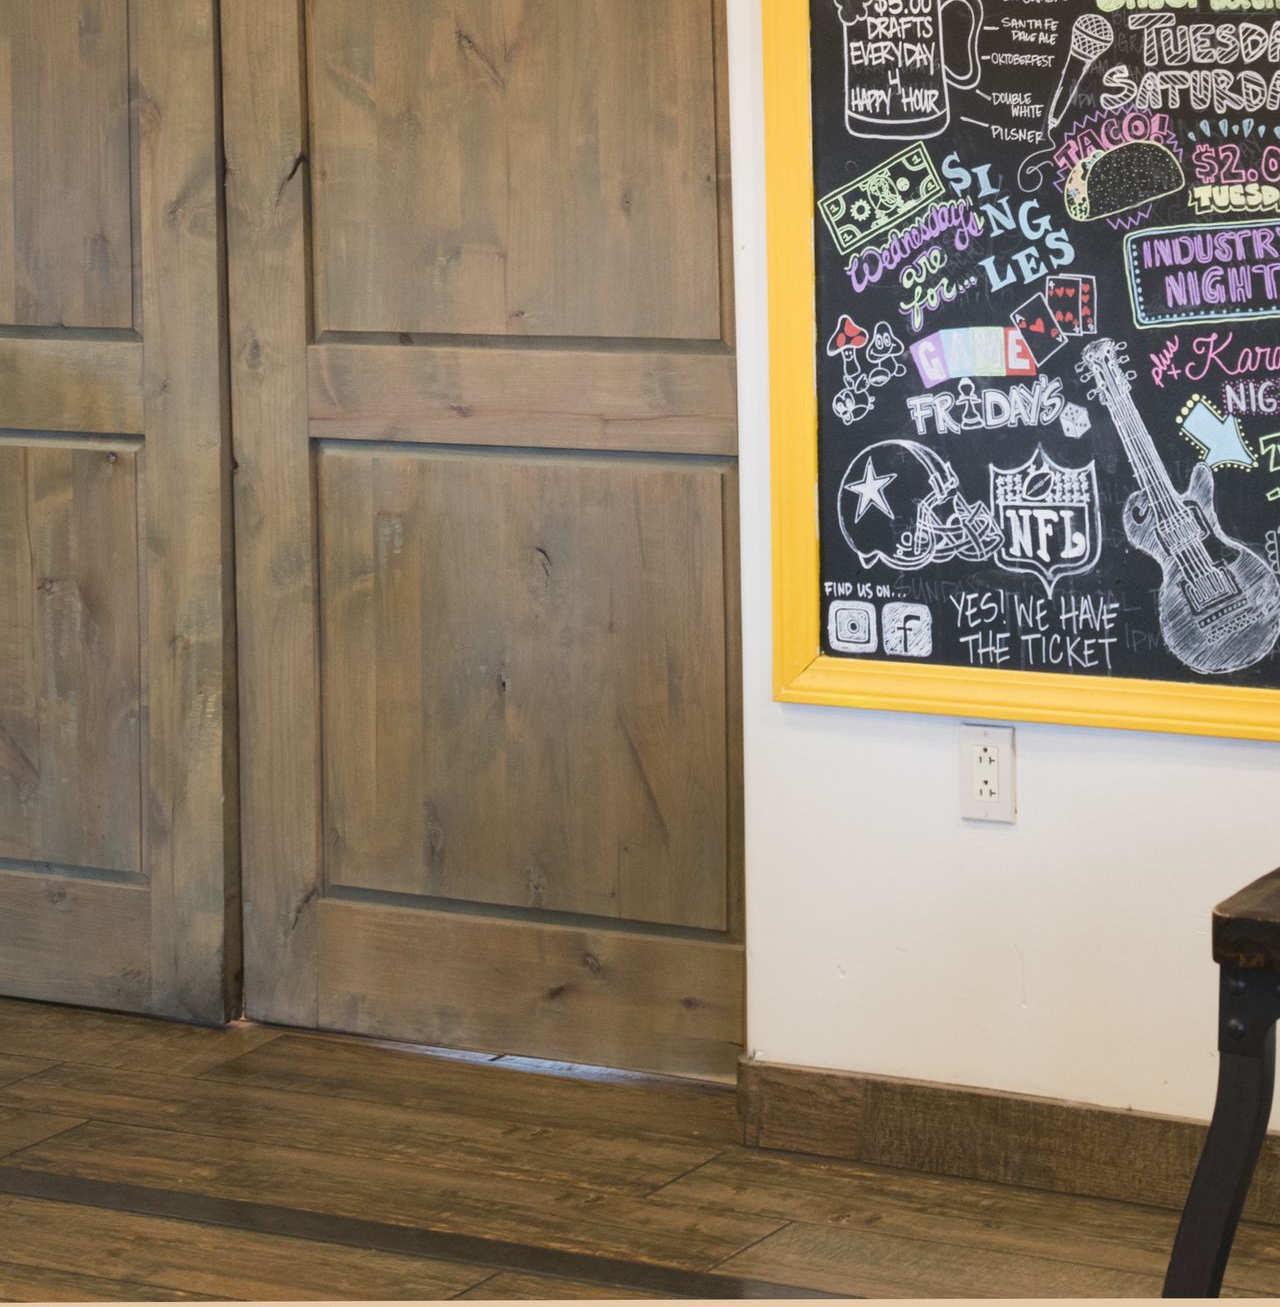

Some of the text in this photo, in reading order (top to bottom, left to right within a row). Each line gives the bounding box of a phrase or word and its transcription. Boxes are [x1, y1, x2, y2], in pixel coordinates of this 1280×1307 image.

[867, 16, 933, 40] DRAFTS
[1001, 17, 1059, 31] SANTA FE
[1038, 32, 1059, 45] ALE
[849, 40, 935, 76] EVERYDAY
[991, 52, 1055, 68] OKTOBERFEST
[888, 68, 901, 94] 4
[851, 86, 940, 116] HAPPY HOUR
[991, 92, 1032, 107] DOUBLE
[1011, 104, 1044, 119] WHITE
[991, 125, 1045, 144] PILSNER
[1053, 112, 1169, 170] TACO!
[899, 246, 948, 289] are
[918, 329, 1030, 382] GAME
[1149, 334, 1180, 389] plus
[1005, 509, 1087, 563] NFL
[824, 581, 853, 597] FIND
[857, 582, 873, 599] US
[949, 588, 1007, 628] YES!
[1014, 594, 1050, 631] WE
[1060, 594, 1120, 637] HAVE
[959, 630, 1011, 665] THE
[1021, 633, 1118, 669] TICKET
